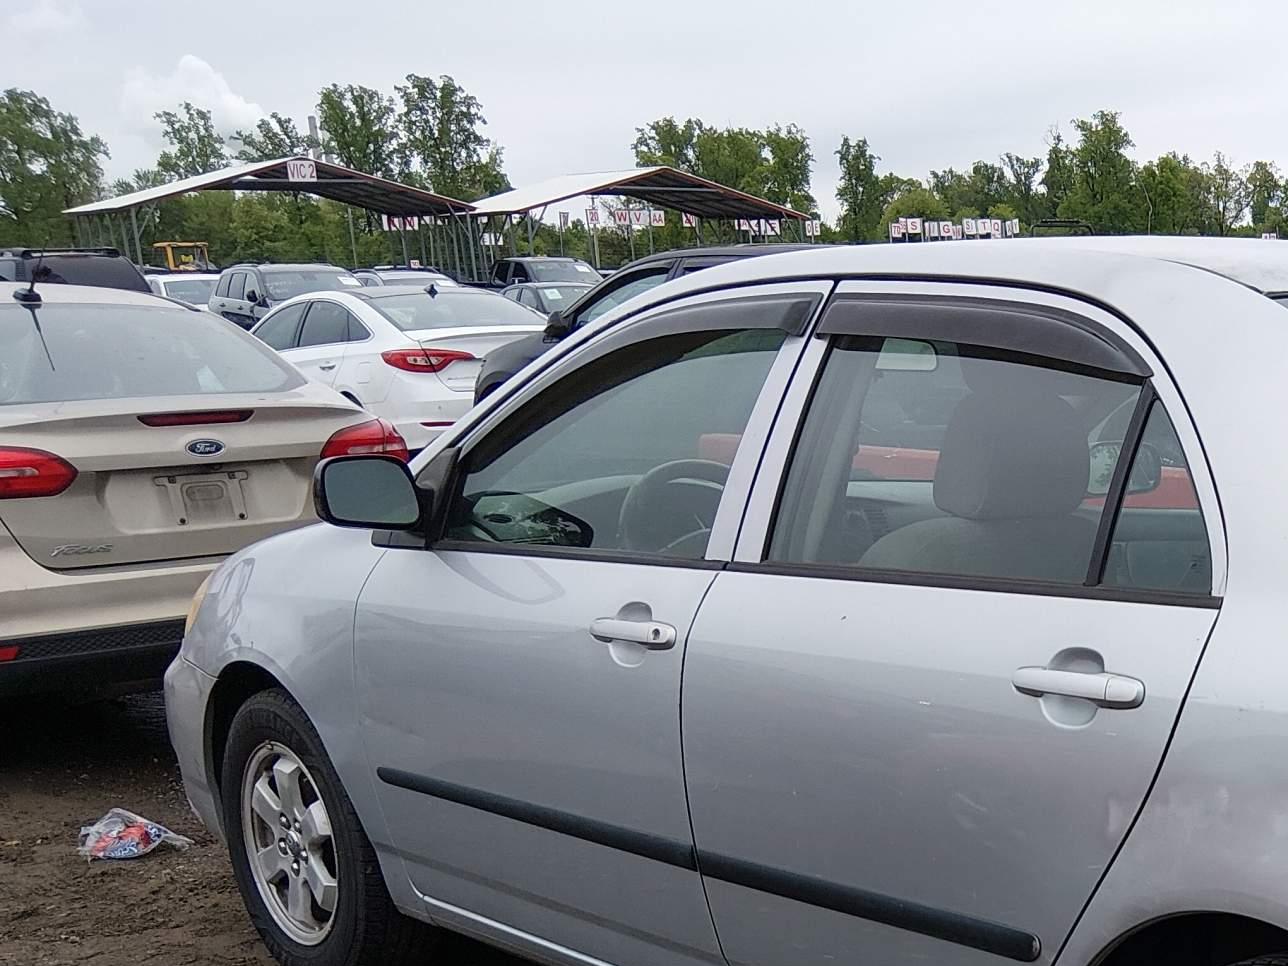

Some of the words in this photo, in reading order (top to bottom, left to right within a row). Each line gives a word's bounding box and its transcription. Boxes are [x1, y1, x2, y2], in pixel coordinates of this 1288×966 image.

[288, 163, 306, 179] VIC
[308, 163, 316, 178] 2
[616, 212, 627, 222] W
[633, 212, 642, 222] V
[910, 221, 918, 230] S
[942, 224, 950, 233] G
[979, 221, 987, 231] T
[992, 222, 1000, 232] Q
[195, 442, 217, 453] Ford
